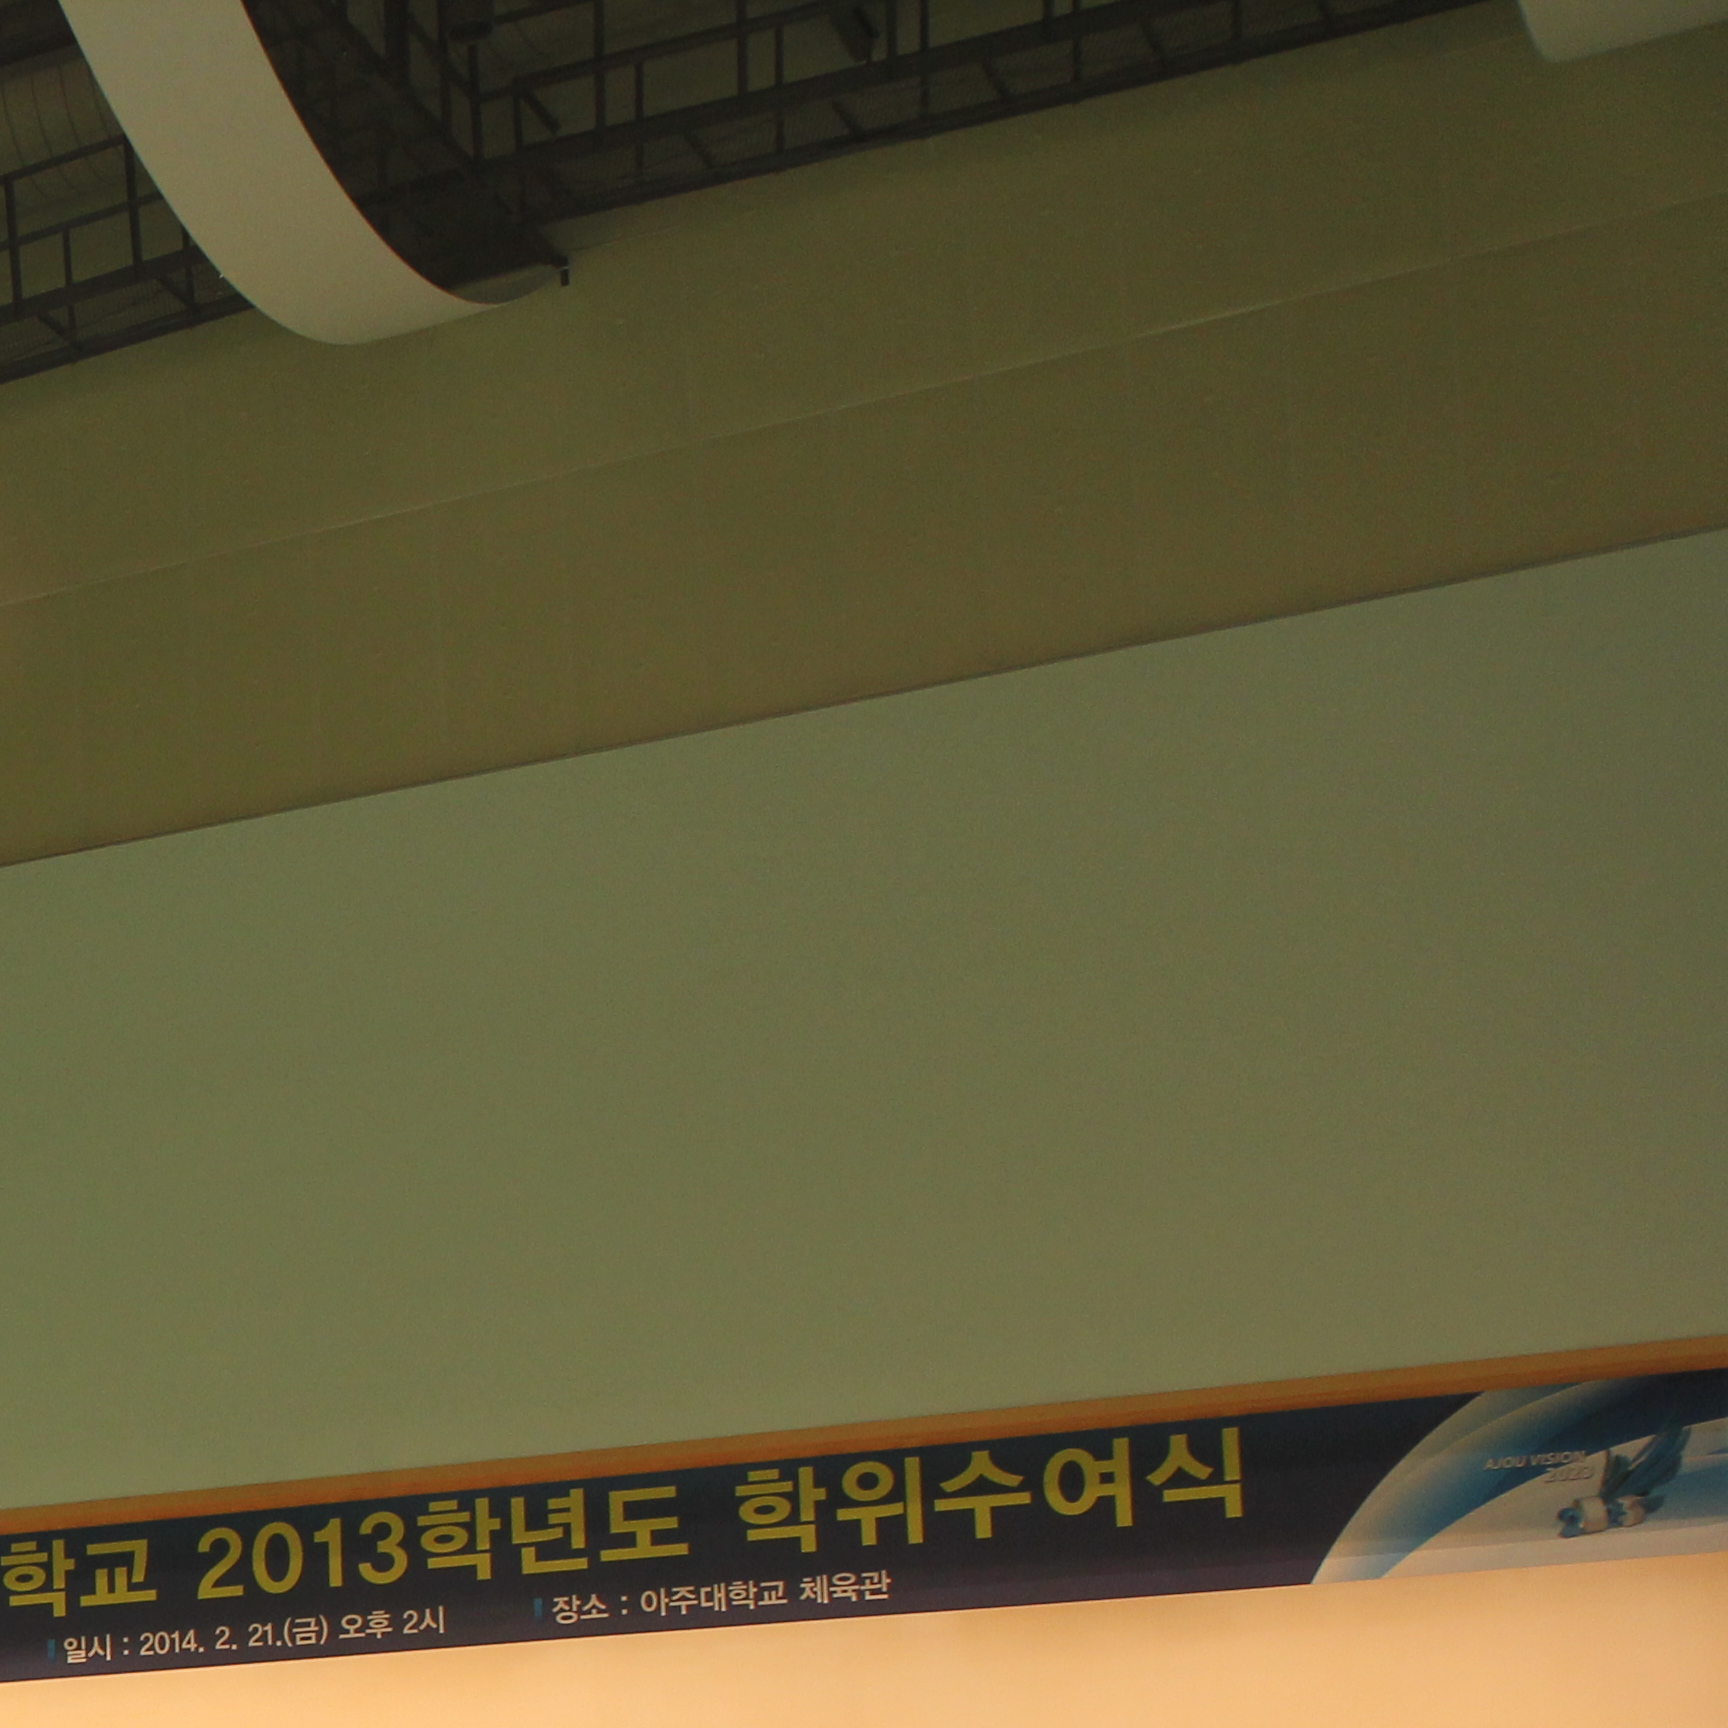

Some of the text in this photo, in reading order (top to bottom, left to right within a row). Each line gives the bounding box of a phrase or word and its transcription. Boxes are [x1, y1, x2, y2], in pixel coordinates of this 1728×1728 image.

[197, 1484, 690, 1600] 2013학년도
[735, 1426, 1244, 1553] 학위수여식
[551, 1594, 609, 1625] 장소
[639, 1578, 788, 1618] 아주대학교
[799, 1569, 892, 1606] 체육관
[62, 1634, 113, 1664] 일시
[139, 1630, 205, 1657] 2014.
[214, 1626, 238, 1652] 2.
[247, 1614, 329, 1649] 21.(금)
[338, 1610, 393, 1641] 오후
[402, 1605, 446, 1635] 2시
